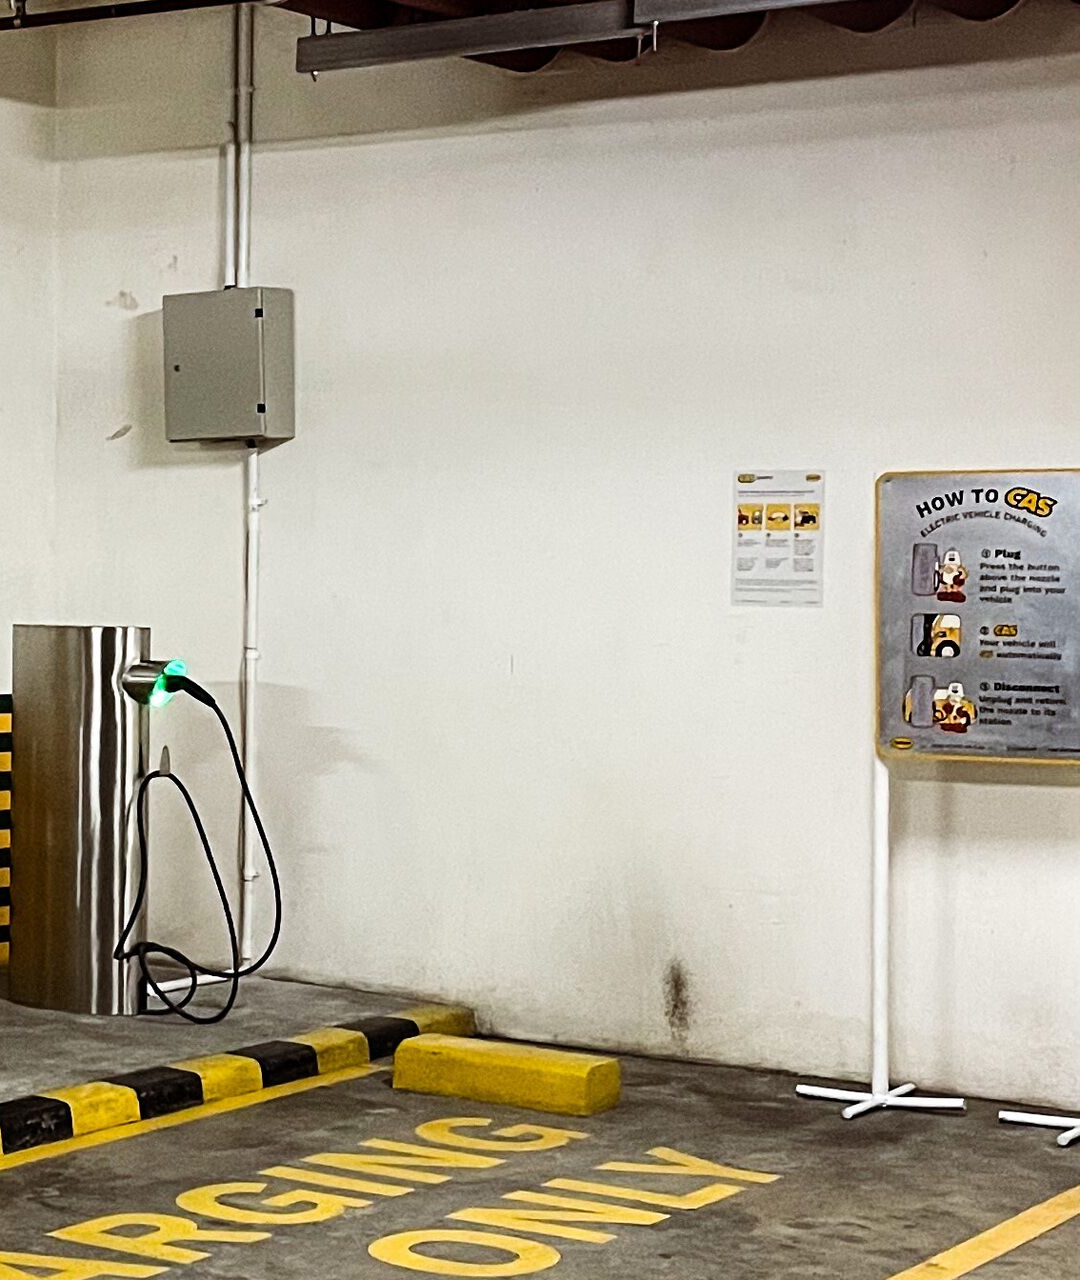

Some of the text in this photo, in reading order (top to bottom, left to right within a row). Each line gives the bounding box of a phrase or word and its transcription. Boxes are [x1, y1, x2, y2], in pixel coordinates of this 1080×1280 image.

[916, 490, 964, 518] HOW
[971, 488, 999, 503] TO
[920, 510, 1047, 538] ELECTRIC VEHICLE CHARGING
[994, 549, 1021, 560] Plug
[980, 562, 1060, 571] Press the button
[1028, 575, 1060, 583] nozzle
[980, 585, 1066, 596] and plug into your
[979, 596, 1012, 604] vehicle
[1002, 640, 1036, 648] vehicle
[1038, 640, 1056, 649] will
[996, 652, 1062, 661] automatically
[993, 682, 1060, 694] Disconnect
[979, 696, 1013, 706] Unplug
[979, 706, 995, 714] the
[1030, 708, 1042, 716] to
[1044, 708, 1057, 717] its
[367, 1146, 782, 1277] ONLY
